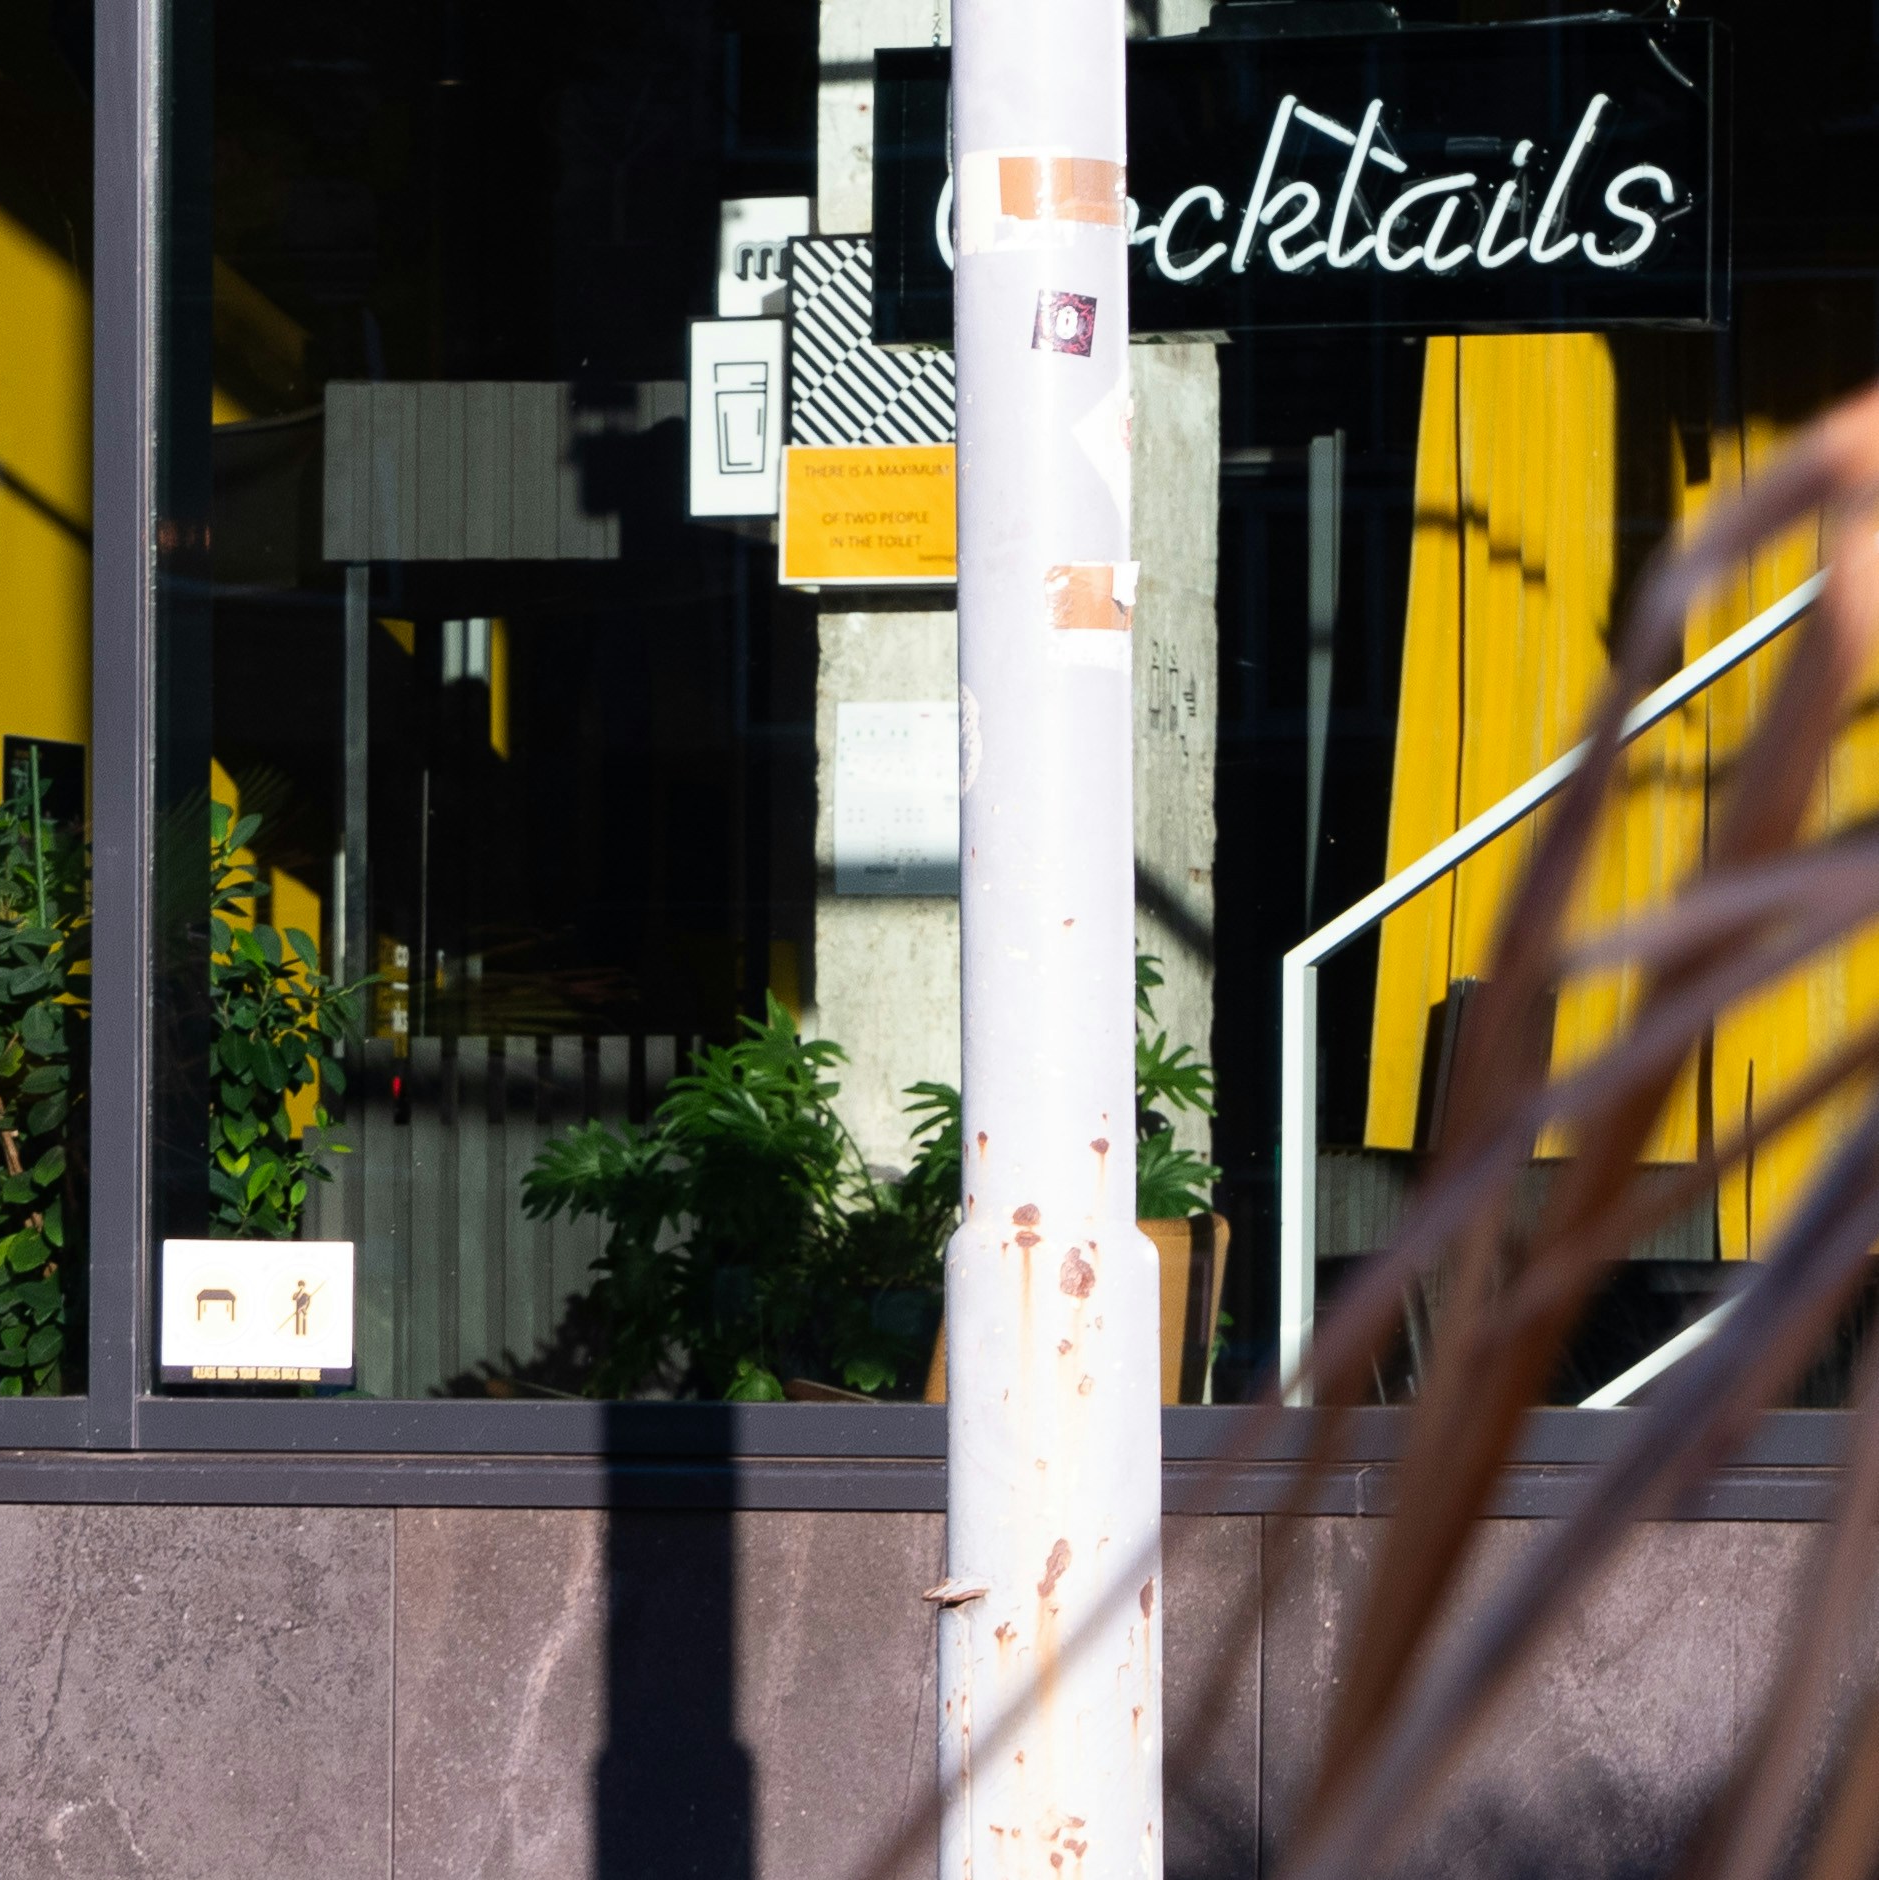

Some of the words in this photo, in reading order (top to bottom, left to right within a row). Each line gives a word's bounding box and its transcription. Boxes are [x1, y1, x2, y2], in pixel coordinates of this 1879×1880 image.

[935, 92, 1678, 282] cktails
[804, 464, 845, 478] THERE
[848, 464, 862, 478] IS
[863, 464, 874, 477] A
[821, 512, 840, 526] OF
[844, 511, 876, 525] TWO
[879, 510, 929, 525] PEOPLE
[828, 535, 844, 549] IN
[848, 534, 873, 549] THE
[877, 534, 923, 549] TOILET
